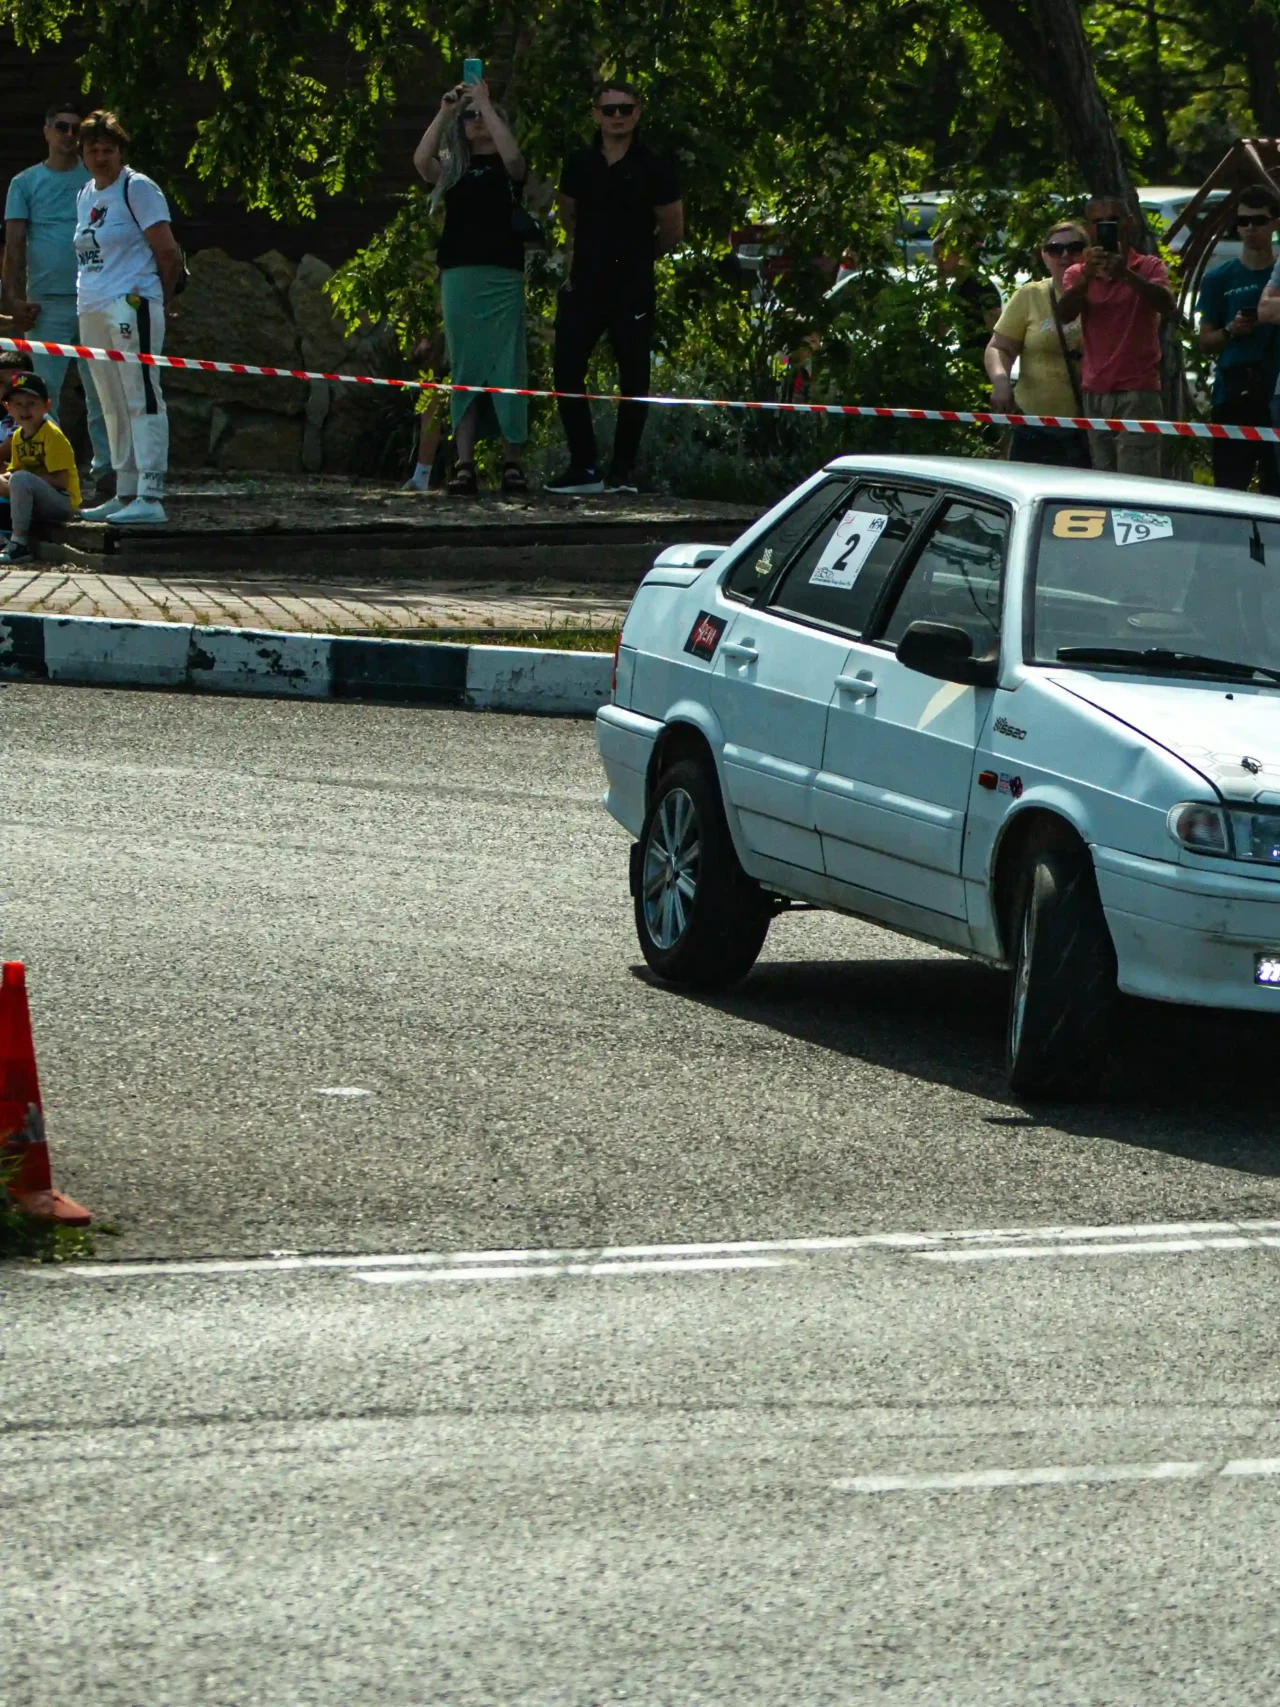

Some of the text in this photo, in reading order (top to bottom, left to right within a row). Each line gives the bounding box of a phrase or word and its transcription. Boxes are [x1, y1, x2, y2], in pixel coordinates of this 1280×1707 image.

[1052, 509, 1107, 539] 6
[1116, 522, 1151, 544] 79
[831, 533, 861, 571] 2
